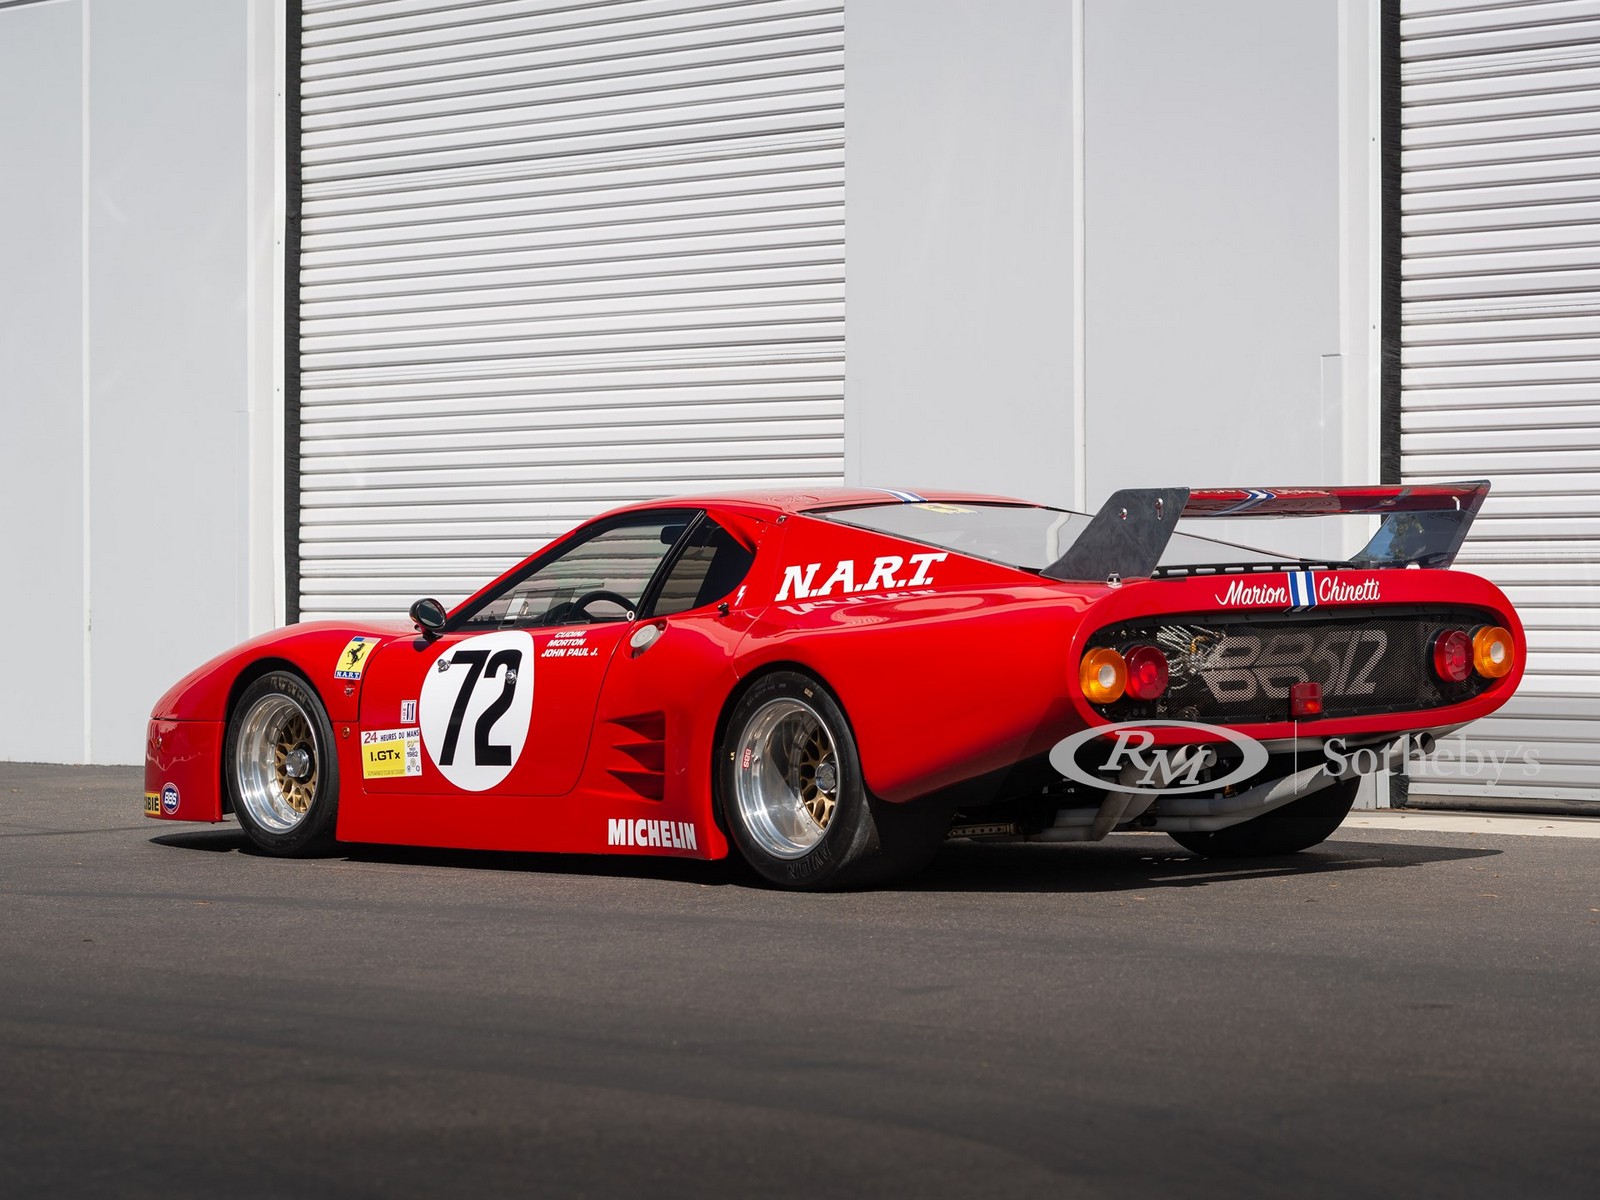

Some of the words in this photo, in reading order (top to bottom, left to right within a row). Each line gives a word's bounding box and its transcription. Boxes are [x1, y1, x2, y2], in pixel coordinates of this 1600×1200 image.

[774, 552, 949, 602] N.A.R.T.
[1215, 580, 1288, 606] Marion
[1319, 576, 1381, 602] Chinetti
[541, 648, 567, 658] JOHN
[566, 647, 589, 657] PAUL
[590, 647, 598, 657] J.
[547, 638, 587, 647] MORTON
[438, 648, 523, 767] 72
[363, 731, 378, 744] 24
[380, 732, 397, 742] HEURES
[398, 731, 405, 740] DU
[406, 730, 420, 739] MANS
[164, 791, 177, 805] BBS
[607, 818, 698, 851] MICHELIN
